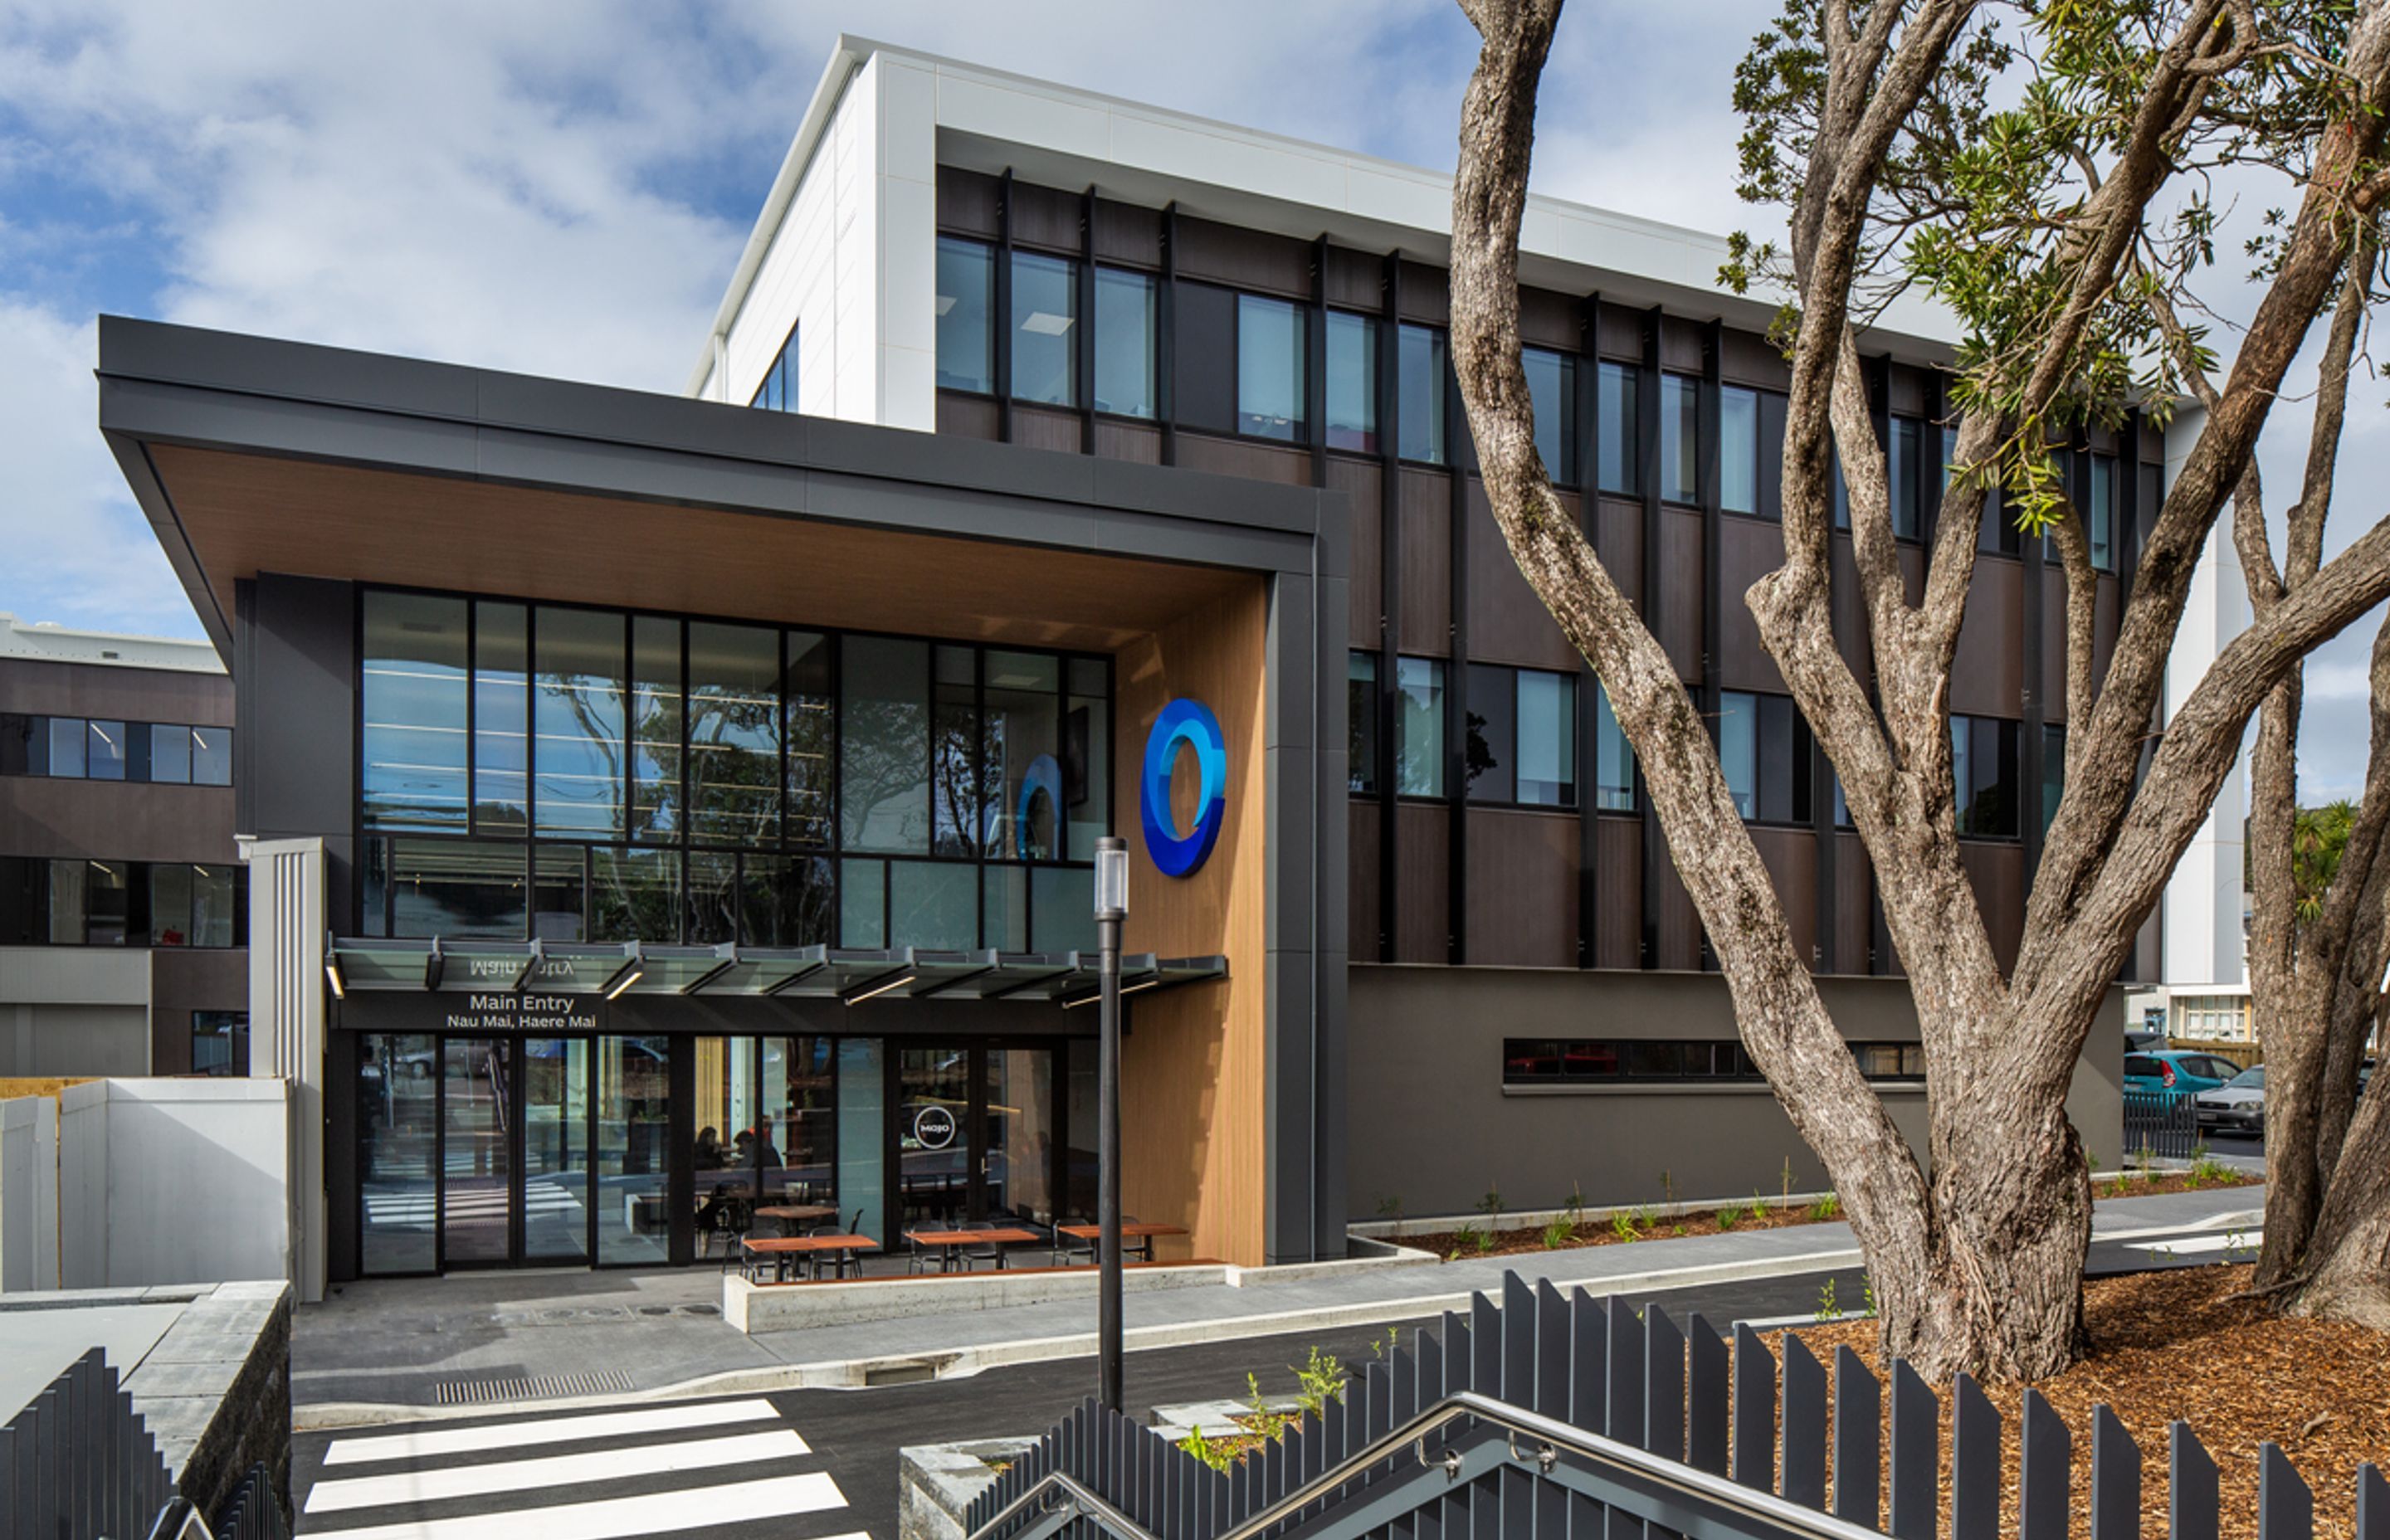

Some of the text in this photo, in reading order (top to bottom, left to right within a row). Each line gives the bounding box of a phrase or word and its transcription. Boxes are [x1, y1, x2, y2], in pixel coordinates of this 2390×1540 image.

[471, 995, 574, 1013] Main Entry
[447, 1015, 597, 1029] Nau Mai, Haere Mai
[920, 1124, 950, 1133] MOJO
